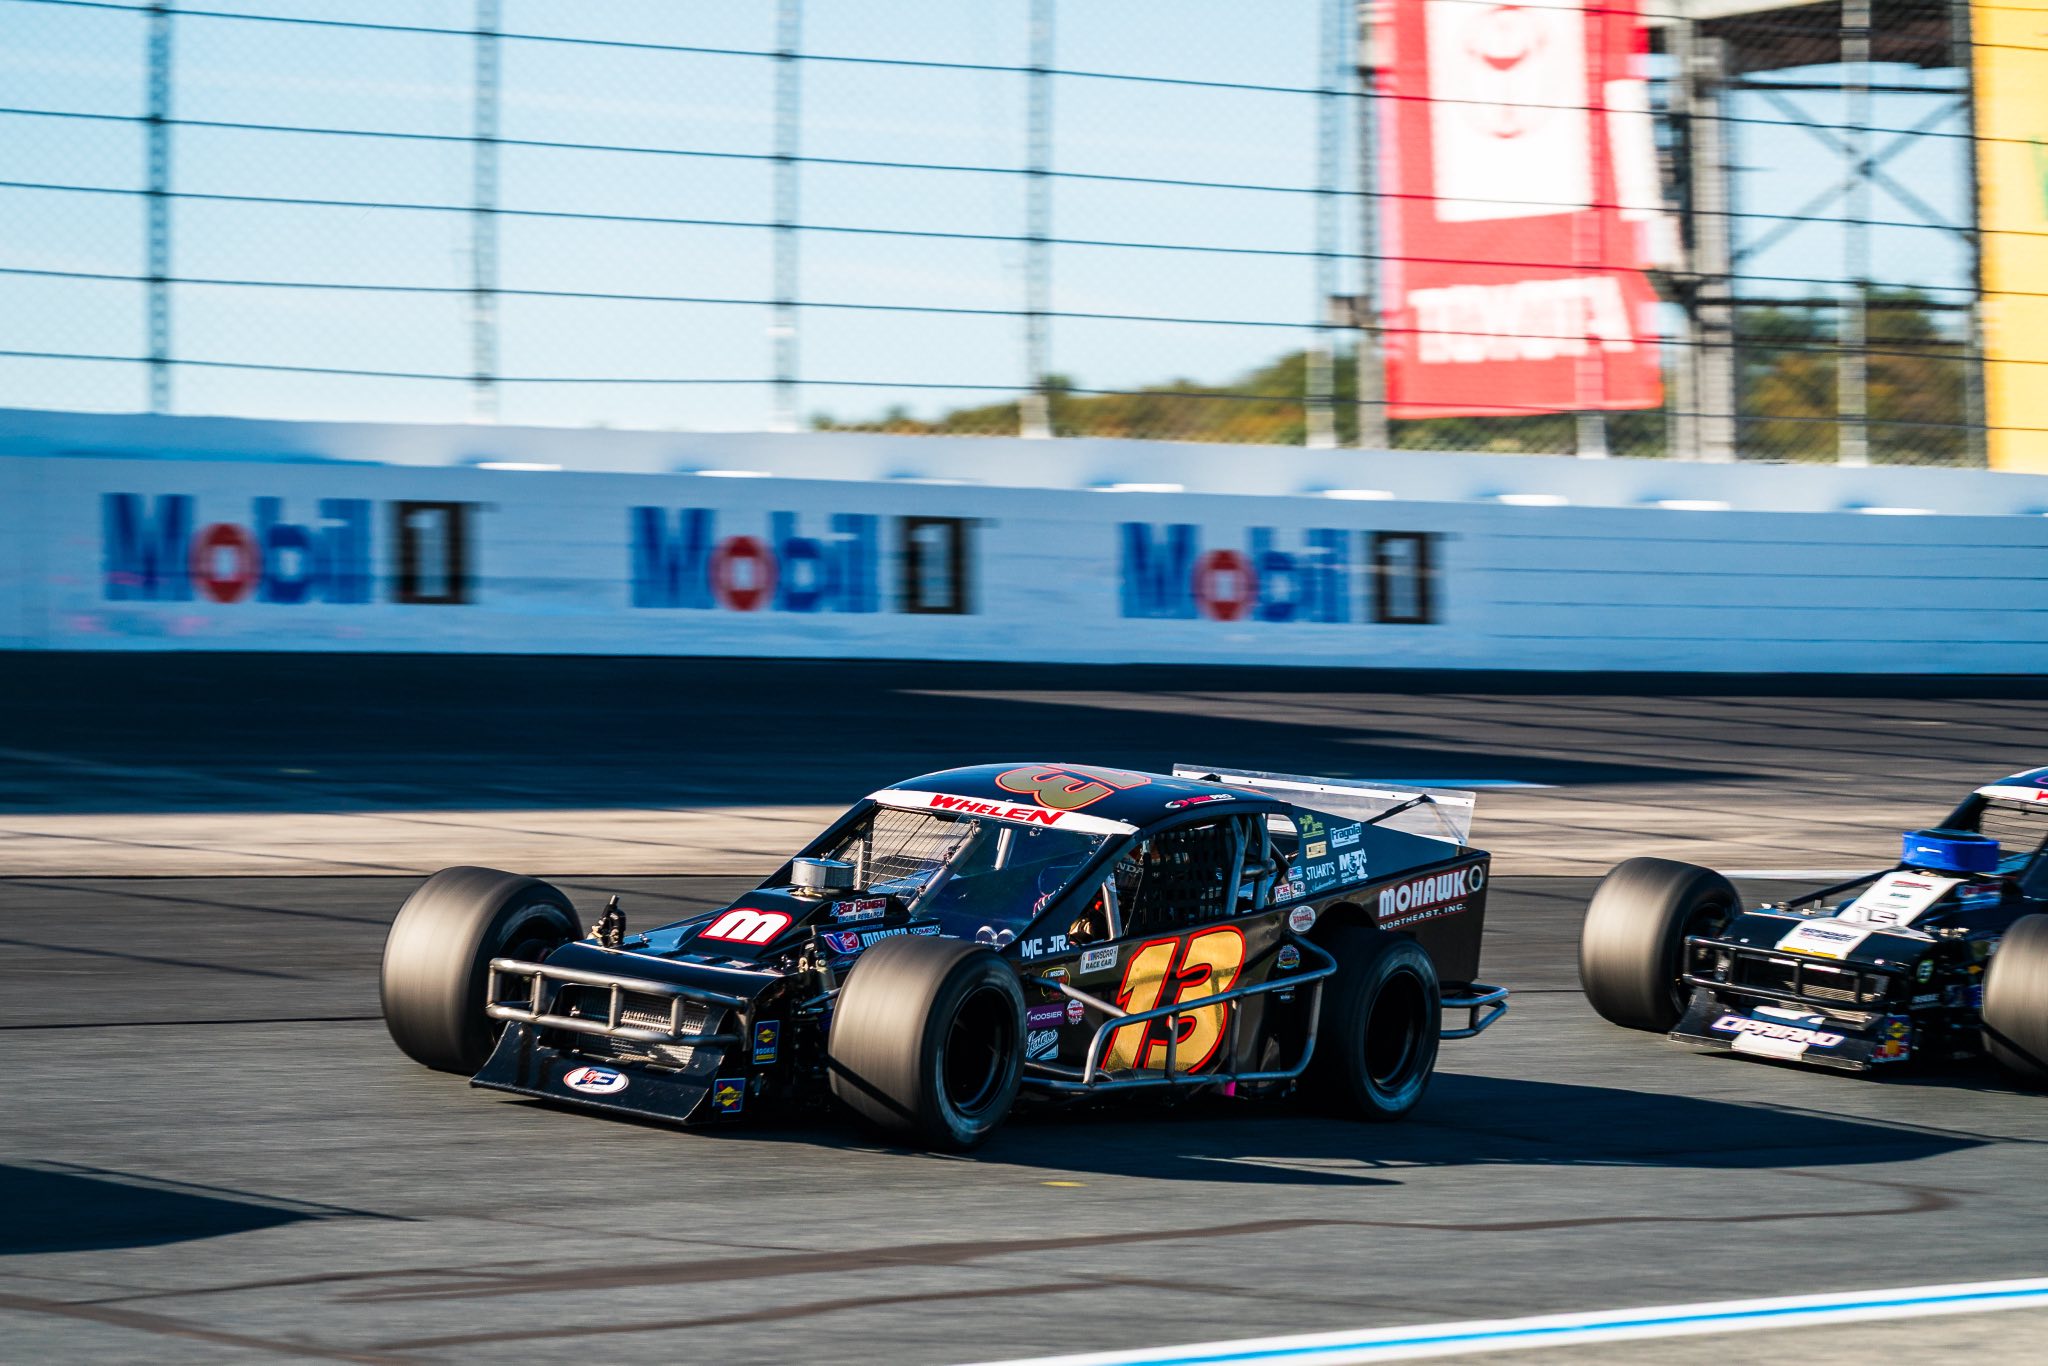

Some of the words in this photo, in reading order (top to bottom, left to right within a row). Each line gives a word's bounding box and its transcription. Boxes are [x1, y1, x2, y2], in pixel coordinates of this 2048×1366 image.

[101, 493, 374, 604] Mobil
[386, 500, 484, 606] 1
[630, 506, 880, 612] Mobil
[892, 515, 982, 616] 1
[1119, 522, 1351, 622] Mobil
[1367, 530, 1448, 625] 1
[929, 794, 1065, 825] WHELEN
[1330, 824, 1361, 841] Fragola
[1306, 862, 1336, 881] STUART'S
[1378, 869, 1468, 917] MOHAWK
[1444, 903, 1467, 913] INC.
[1021, 939, 1043, 959] MC
[1047, 934, 1070, 953] JR.
[1085, 960, 1100, 970] RACE
[1100, 958, 1112, 969] CAR
[1101, 925, 1247, 1074] 13
[1031, 1011, 1062, 1021] HOOSIER
[1711, 1014, 1846, 1048] CIPRIANO
